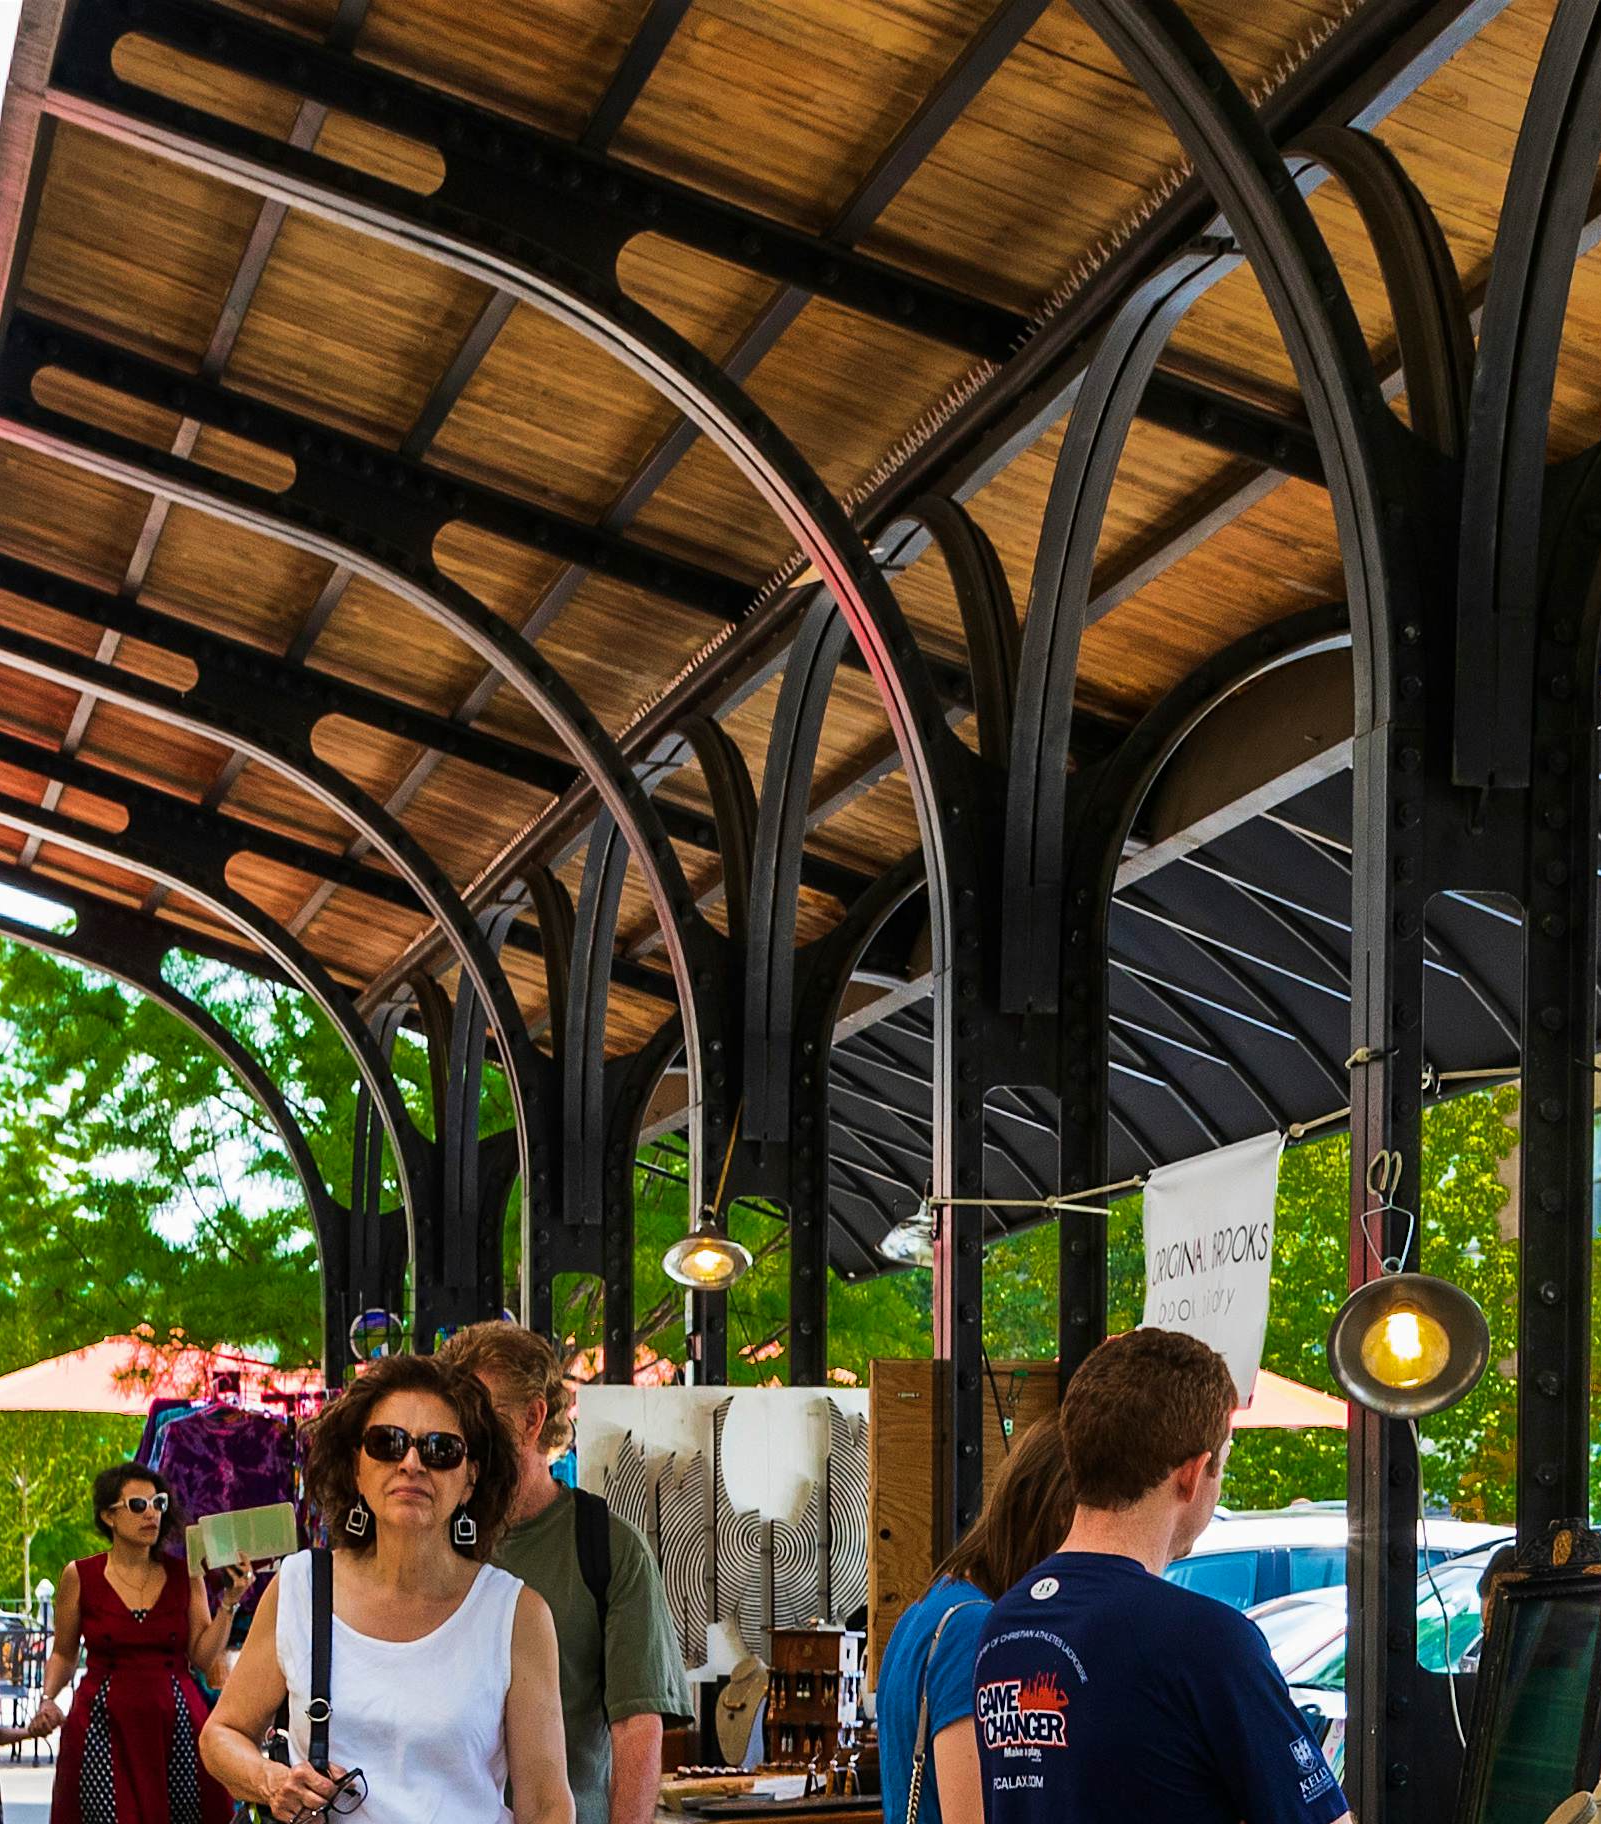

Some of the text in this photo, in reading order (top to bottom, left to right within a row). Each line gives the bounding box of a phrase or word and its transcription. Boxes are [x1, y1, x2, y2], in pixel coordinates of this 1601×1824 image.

[1000, 1629, 1034, 1644] CHRISTIAN
[1034, 1630, 1063, 1648] ATHLETES
[977, 1681, 1020, 1720] GAME
[985, 1710, 1067, 1747] CHANGER
[1003, 1747, 1024, 1758] Make
